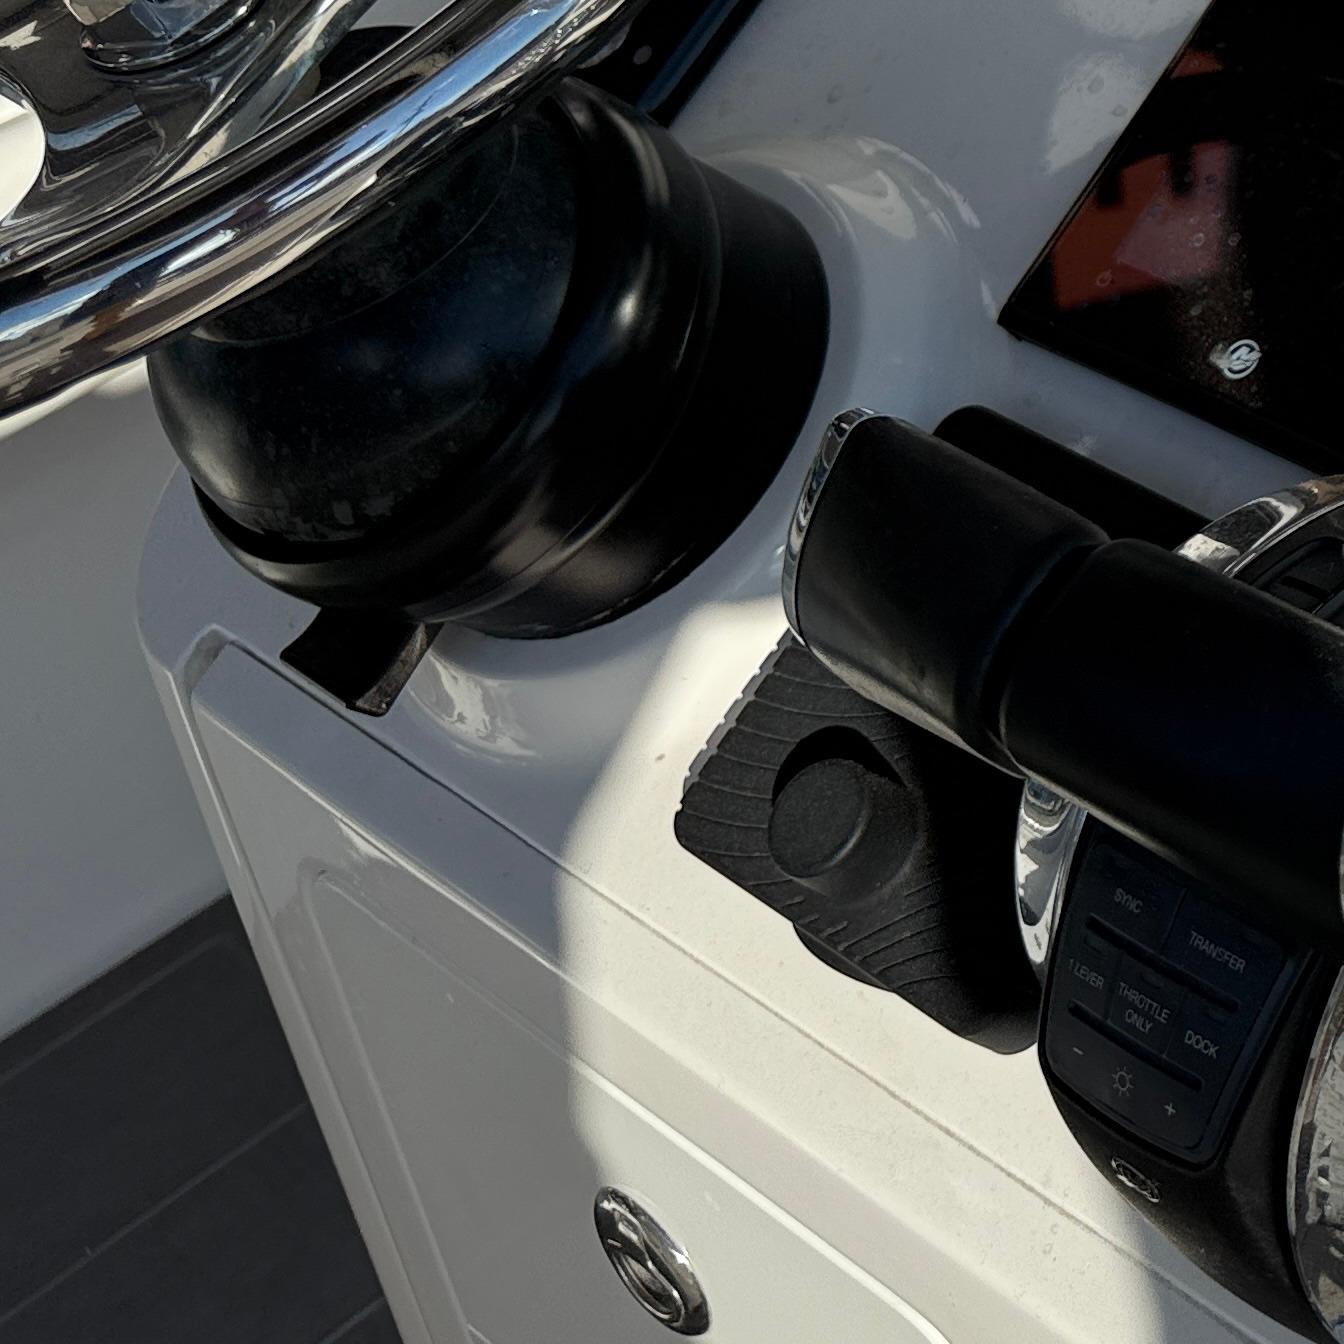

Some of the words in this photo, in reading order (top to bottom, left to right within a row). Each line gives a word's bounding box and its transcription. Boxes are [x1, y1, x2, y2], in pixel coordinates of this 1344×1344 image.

[1113, 887, 1144, 913] SYNC
[1187, 930, 1247, 974] TRANSFER
[1073, 964, 1105, 990] LEVER
[1118, 981, 1172, 1024] THROTTLE
[1124, 1008, 1154, 1034] ONLY
[1183, 1029, 1220, 1059] DOCK
